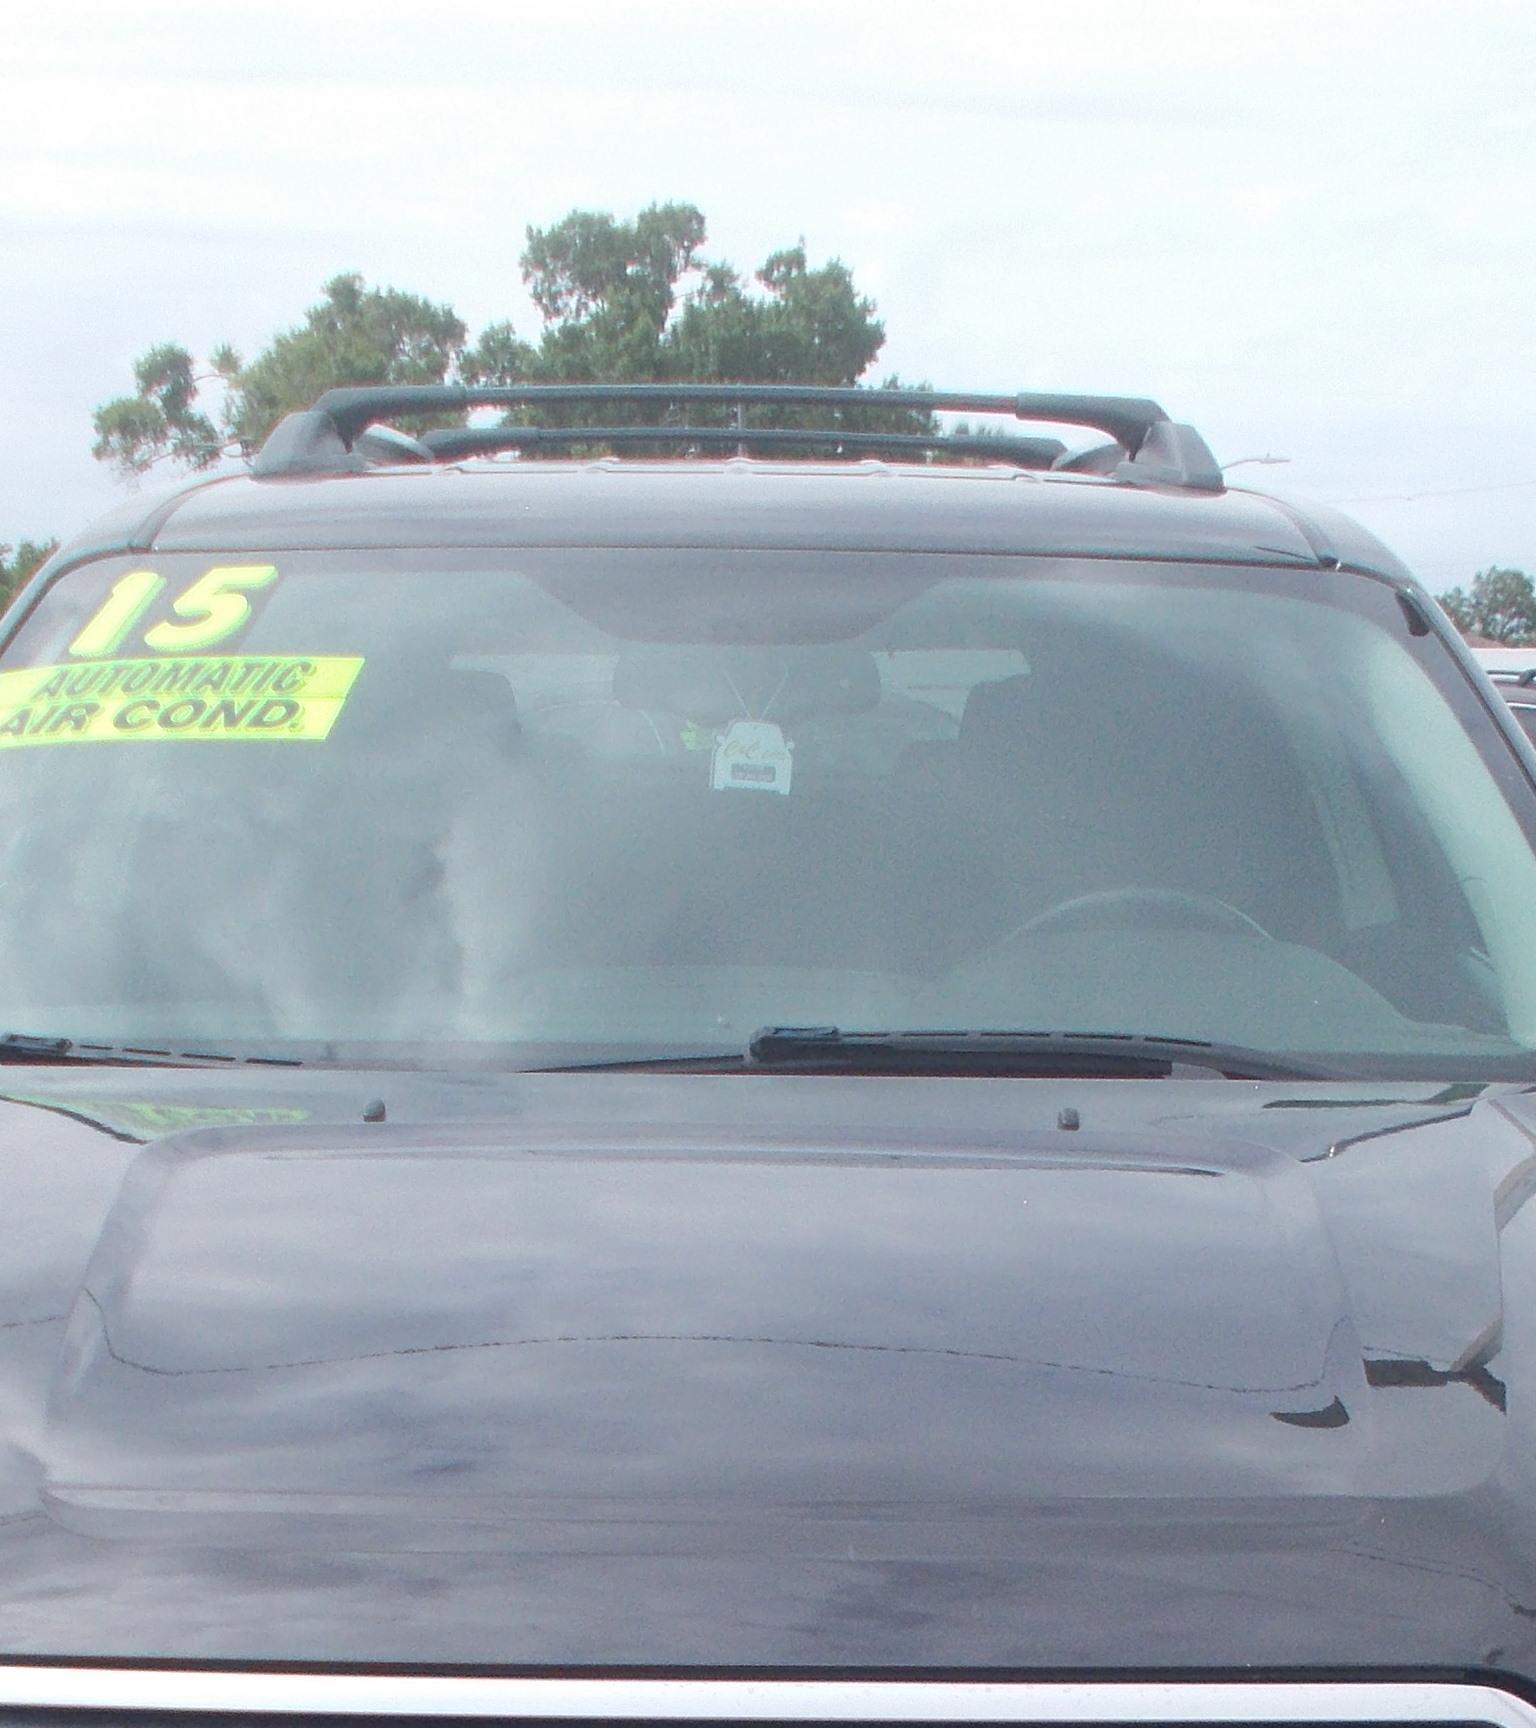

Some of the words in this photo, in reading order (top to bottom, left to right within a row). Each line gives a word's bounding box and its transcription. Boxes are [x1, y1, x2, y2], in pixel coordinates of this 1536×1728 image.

[69, 565, 278, 657] 15
[31, 661, 316, 699] AUTOMATIC
[113, 699, 304, 733] COND.
